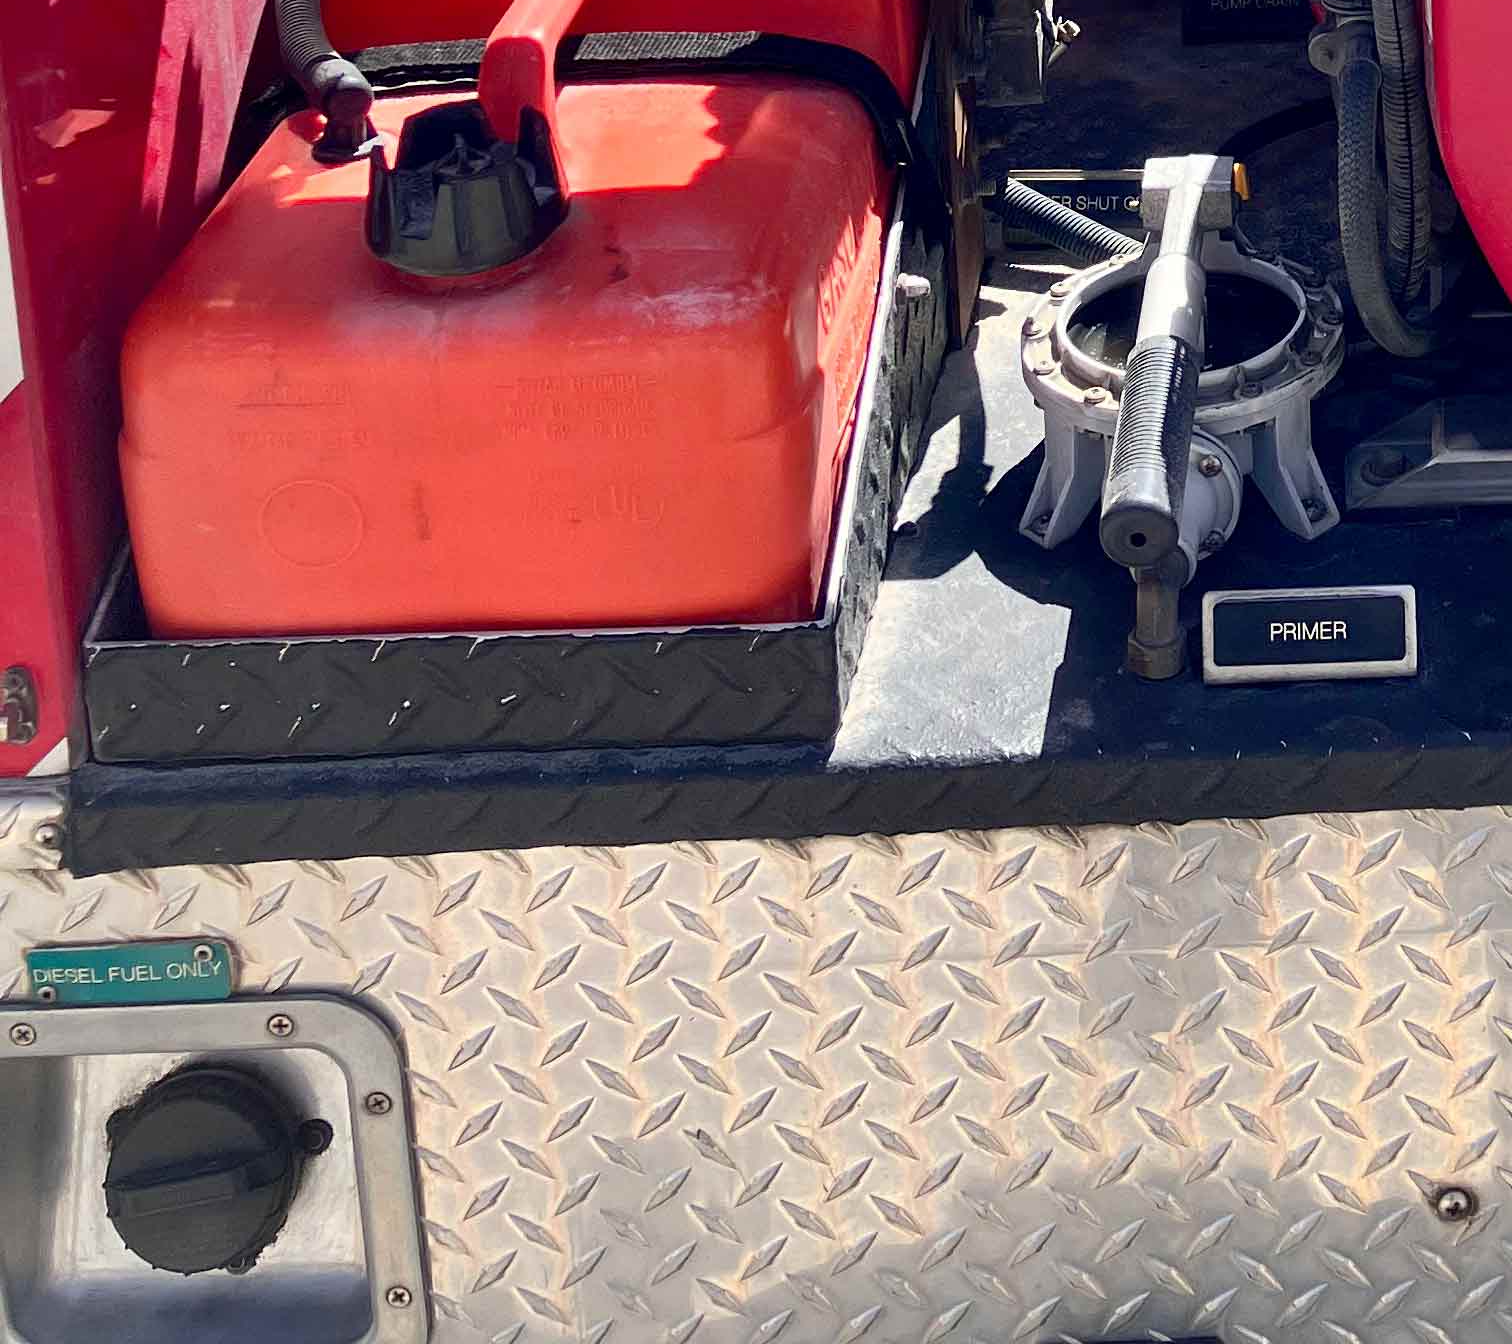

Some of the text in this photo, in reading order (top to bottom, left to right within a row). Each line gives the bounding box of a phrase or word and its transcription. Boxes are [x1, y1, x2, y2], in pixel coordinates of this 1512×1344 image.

[1076, 195, 1119, 210] SHUT
[1270, 620, 1348, 642] PRIMER
[33, 960, 223, 984] DIESEL FUEL ONLY
